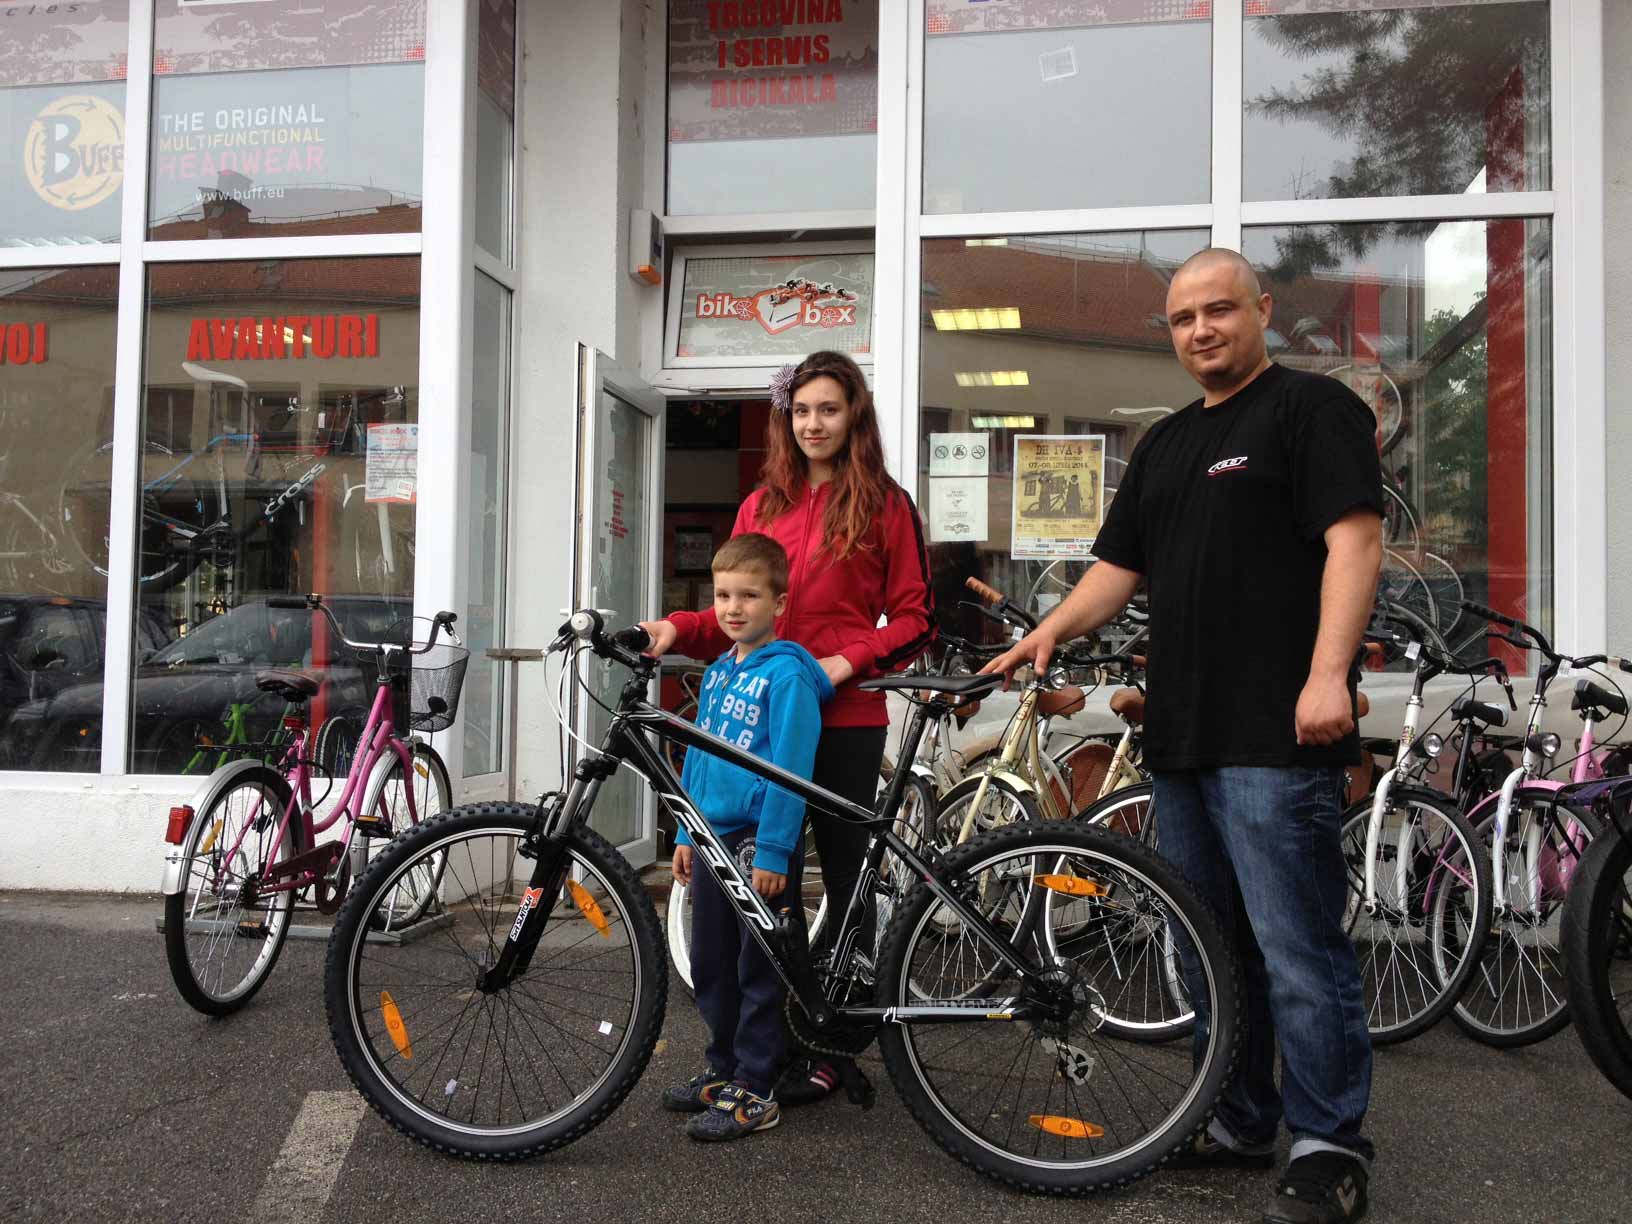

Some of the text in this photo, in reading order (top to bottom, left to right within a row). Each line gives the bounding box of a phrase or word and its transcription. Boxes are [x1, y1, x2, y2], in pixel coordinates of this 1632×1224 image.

[718, 34, 830, 68] I SERVIS
[711, 74, 837, 108] BICIKALA
[160, 103, 325, 133] THE ORIGINAL
[159, 128, 327, 152] MULTIFUNCTIONAL
[159, 145, 326, 180] HEADWEAR
[195, 187, 285, 202] www.buff.eu
[187, 314, 379, 360] AVANTURI
